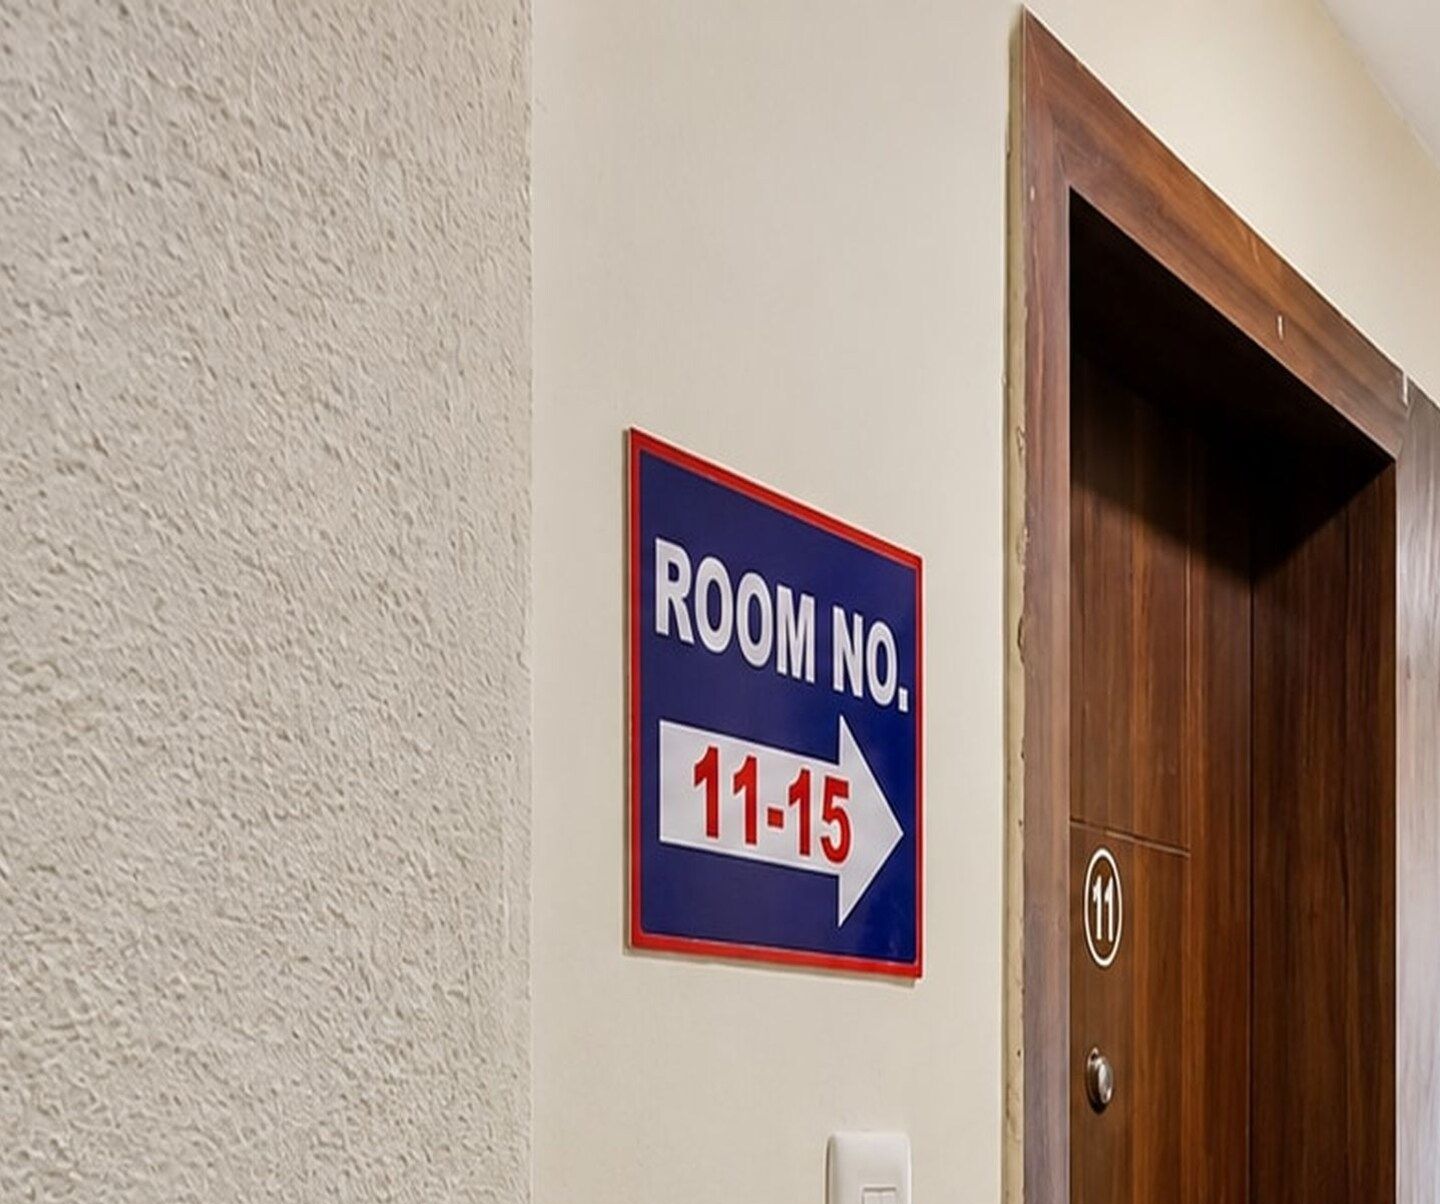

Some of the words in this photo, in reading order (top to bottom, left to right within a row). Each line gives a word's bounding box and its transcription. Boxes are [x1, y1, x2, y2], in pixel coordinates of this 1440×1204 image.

[654, 537, 816, 684] ROOM
[833, 605, 909, 712] NO.
[693, 745, 851, 866] 11-15
[1092, 874, 1114, 942] 11
